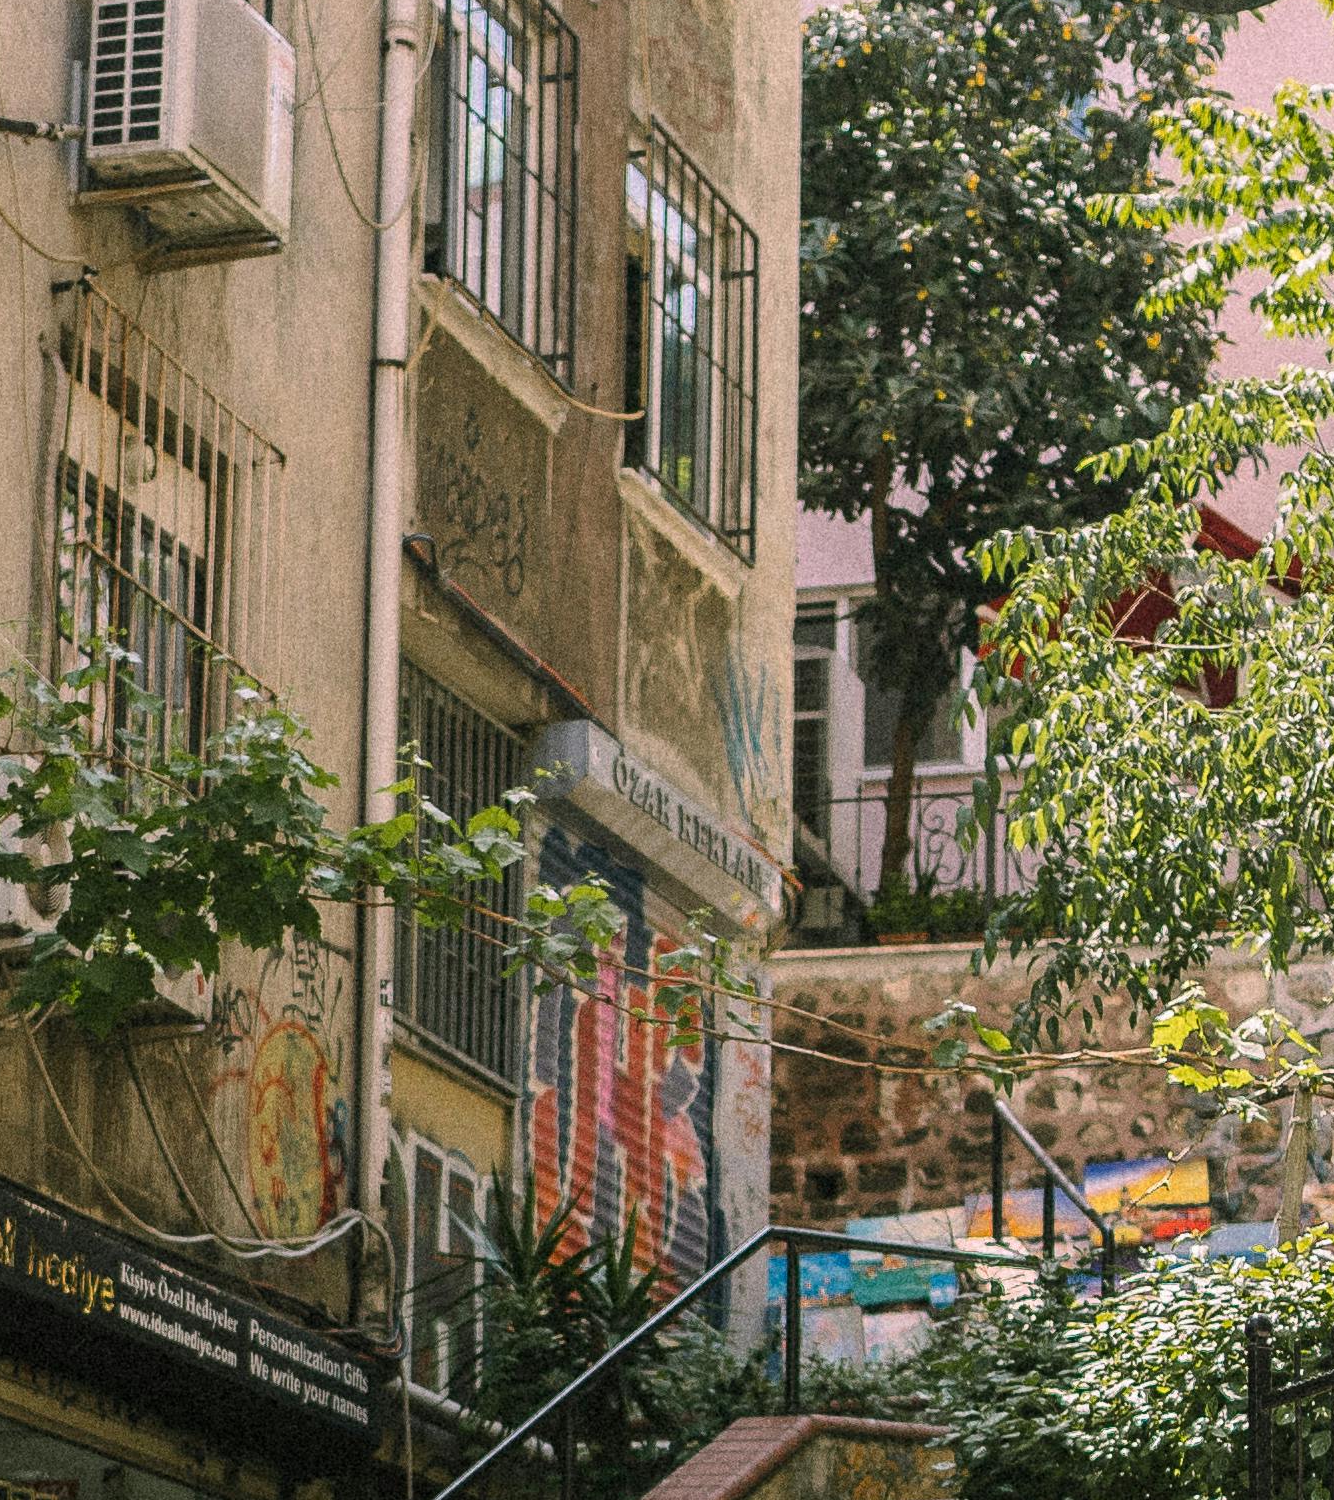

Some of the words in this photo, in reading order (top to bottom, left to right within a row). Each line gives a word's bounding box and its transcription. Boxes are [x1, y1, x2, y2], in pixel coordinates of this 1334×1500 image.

[678, 804, 762, 900] REKLAM
[121, 1262, 156, 1298] Kişiye
[158, 1275, 184, 1309] Özel
[185, 1292, 238, 1333] Hediyeler
[120, 1303, 237, 1368] www.idealhediye.com
[250, 1318, 341, 1380] Personalization
[343, 1361, 368, 1393] Gifts
[250, 1352, 269, 1380] We
[272, 1367, 301, 1394] write
[303, 1380, 330, 1404] your
[333, 1394, 368, 1425] names
